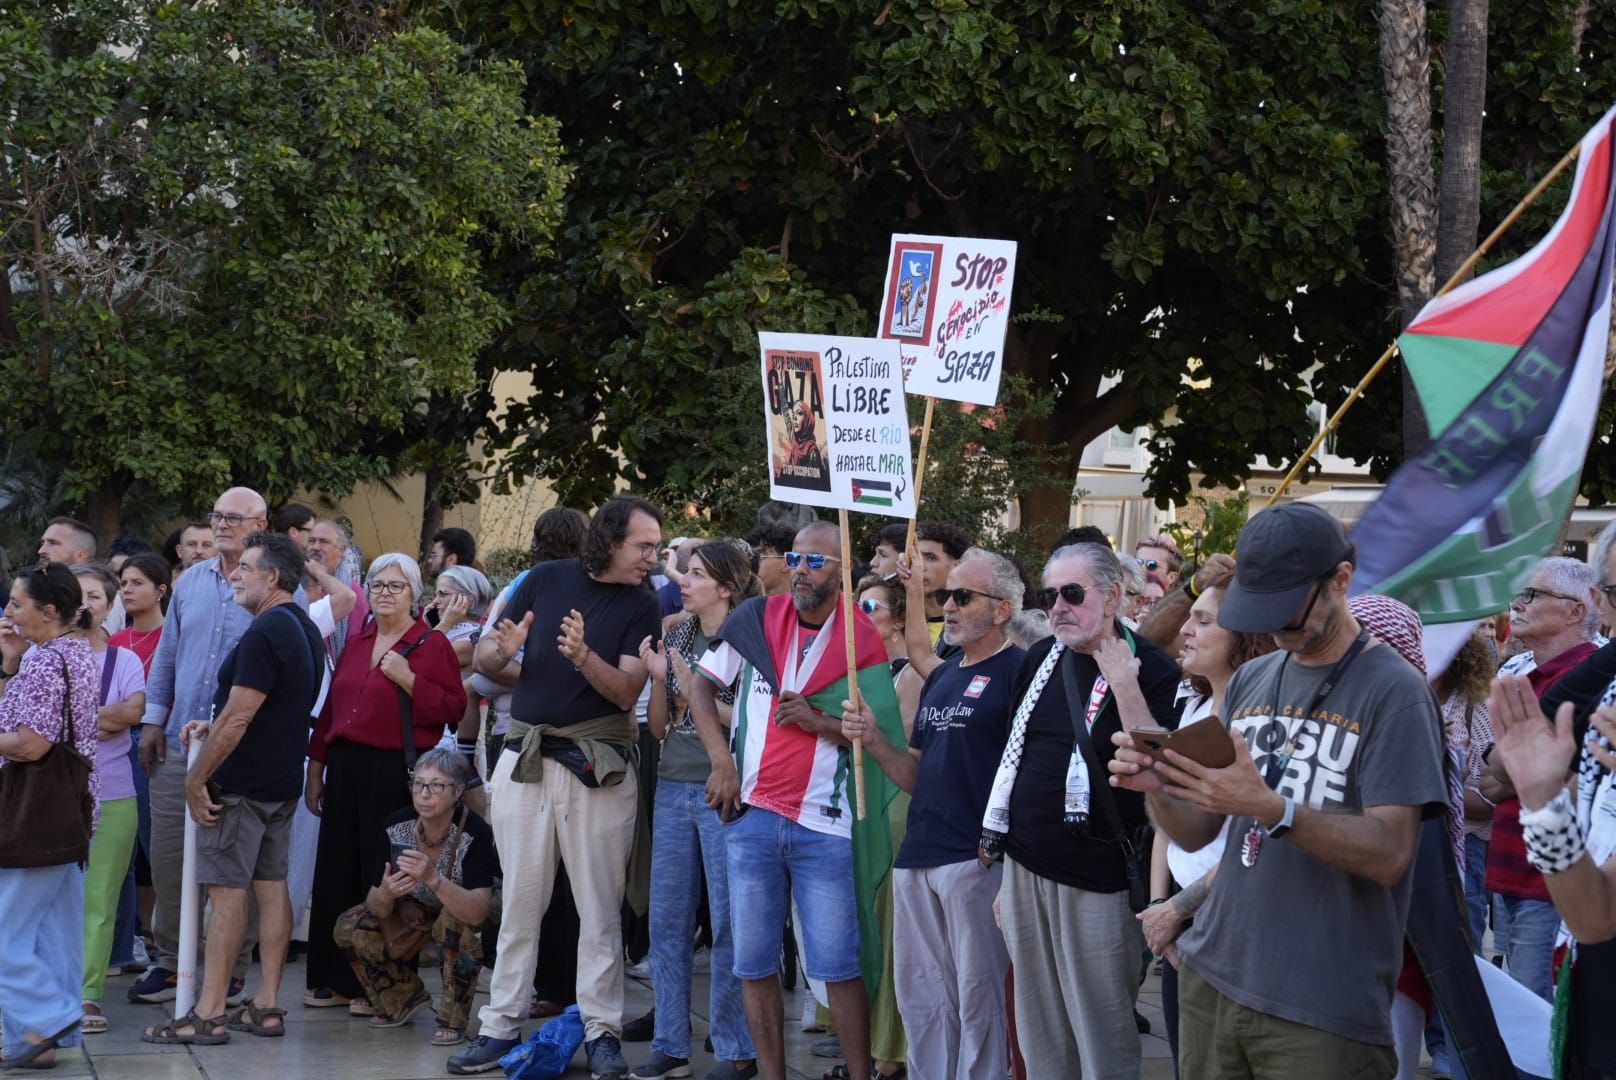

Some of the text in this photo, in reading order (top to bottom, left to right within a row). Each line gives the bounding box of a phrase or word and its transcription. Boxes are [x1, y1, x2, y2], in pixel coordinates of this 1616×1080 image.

[951, 252, 1008, 291] STOP
[966, 315, 989, 339] EN
[937, 350, 996, 383] GAZA
[767, 368, 824, 419] GAZA
[836, 454, 865, 473] HASTA
[878, 453, 905, 476] MAR
[1260, 485, 1290, 495] SOE
